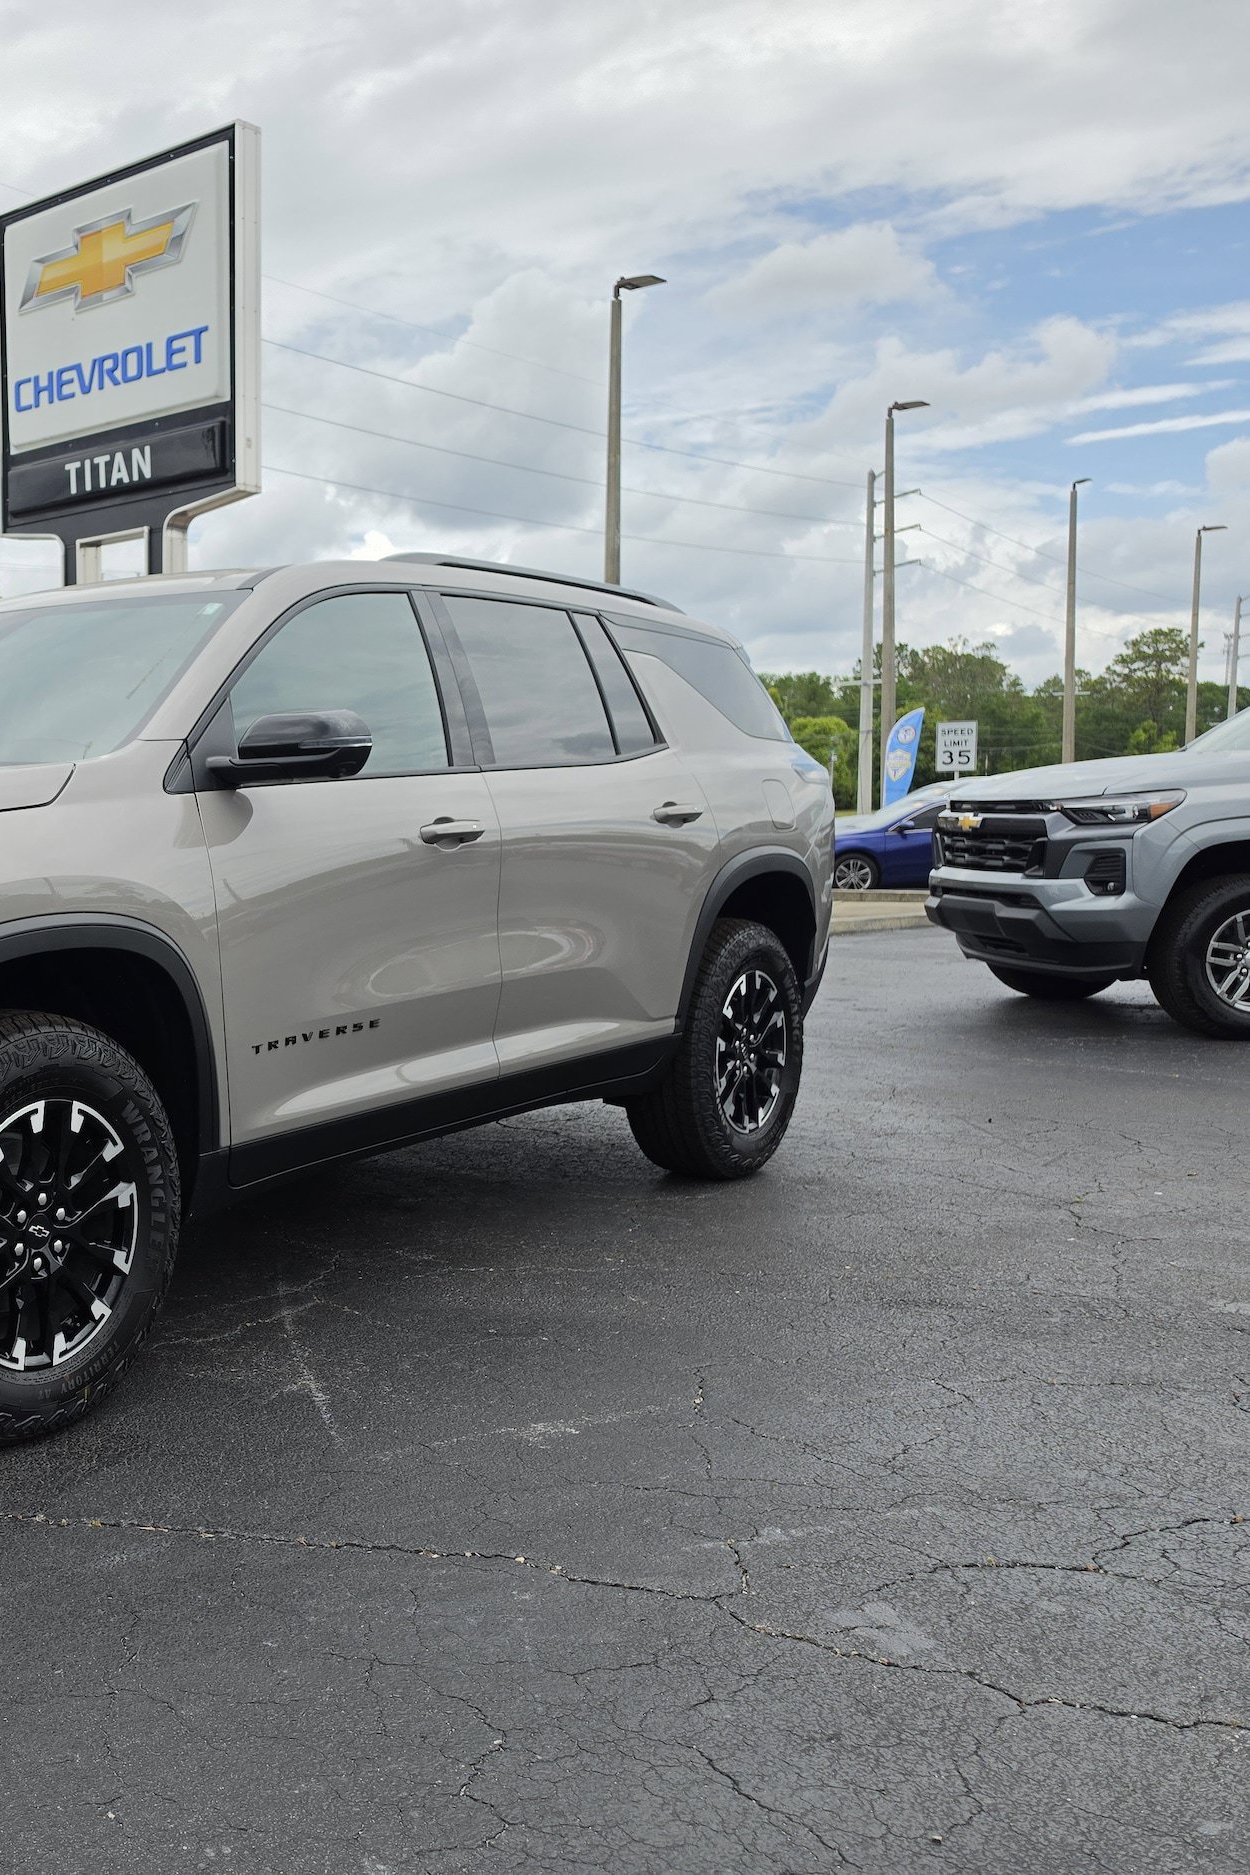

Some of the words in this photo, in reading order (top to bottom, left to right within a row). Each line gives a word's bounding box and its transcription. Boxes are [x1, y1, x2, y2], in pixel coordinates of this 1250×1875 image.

[14, 325, 209, 413] CHEVROLET
[64, 445, 152, 495] TITAN
[941, 727, 974, 736] SPEED
[942, 750, 971, 765] 35
[252, 1019, 381, 1055] TRAVERSE
[60, 1339, 121, 1395] TERRITORY
